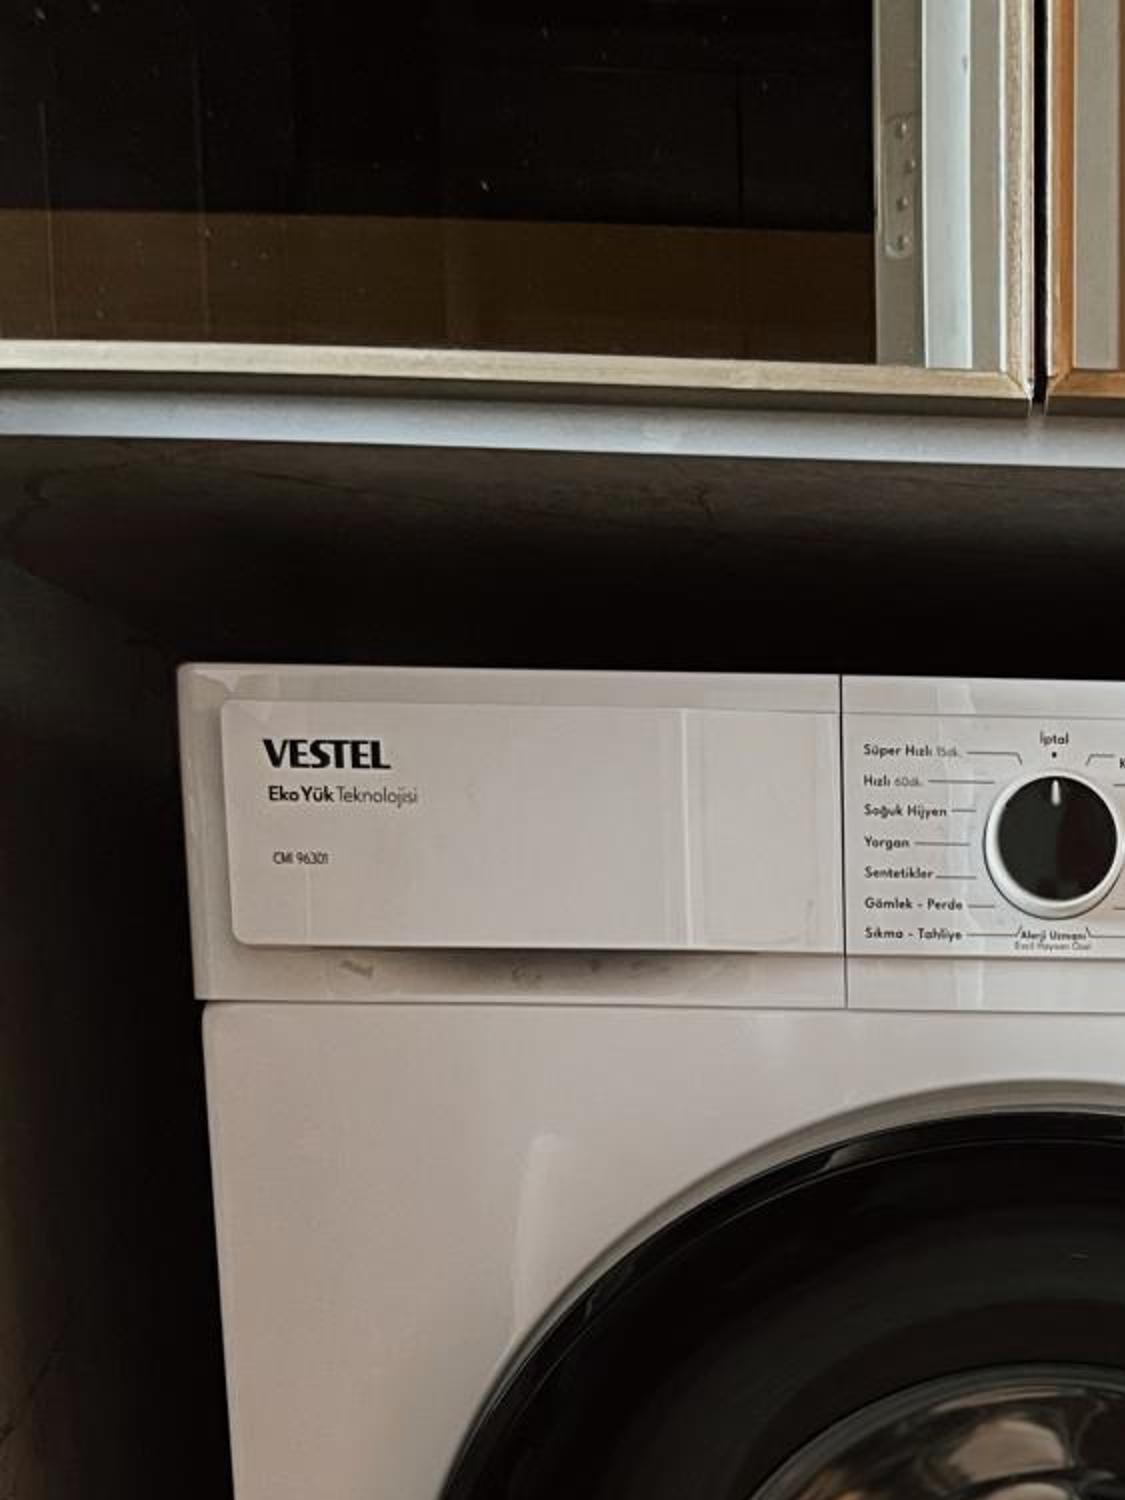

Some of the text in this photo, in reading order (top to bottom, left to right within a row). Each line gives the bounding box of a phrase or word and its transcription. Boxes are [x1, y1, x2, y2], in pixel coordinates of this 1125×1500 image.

[1039, 731, 1069, 746] İptal
[262, 738, 391, 769] VESTEL
[864, 744, 901, 758] Süper
[906, 744, 932, 756] Hızlı
[864, 774, 890, 786] Hızlı
[268, 785, 418, 808] Eko Yük Teknolojisi
[864, 804, 947, 819] Soğuk Hijyen
[864, 836, 910, 850] Yorgan
[864, 866, 934, 878] Sentetikler
[865, 897, 912, 908] Gömlek
[927, 898, 963, 910] Perde
[865, 928, 903, 938] Sıkma
[918, 928, 962, 941] Tahliye
